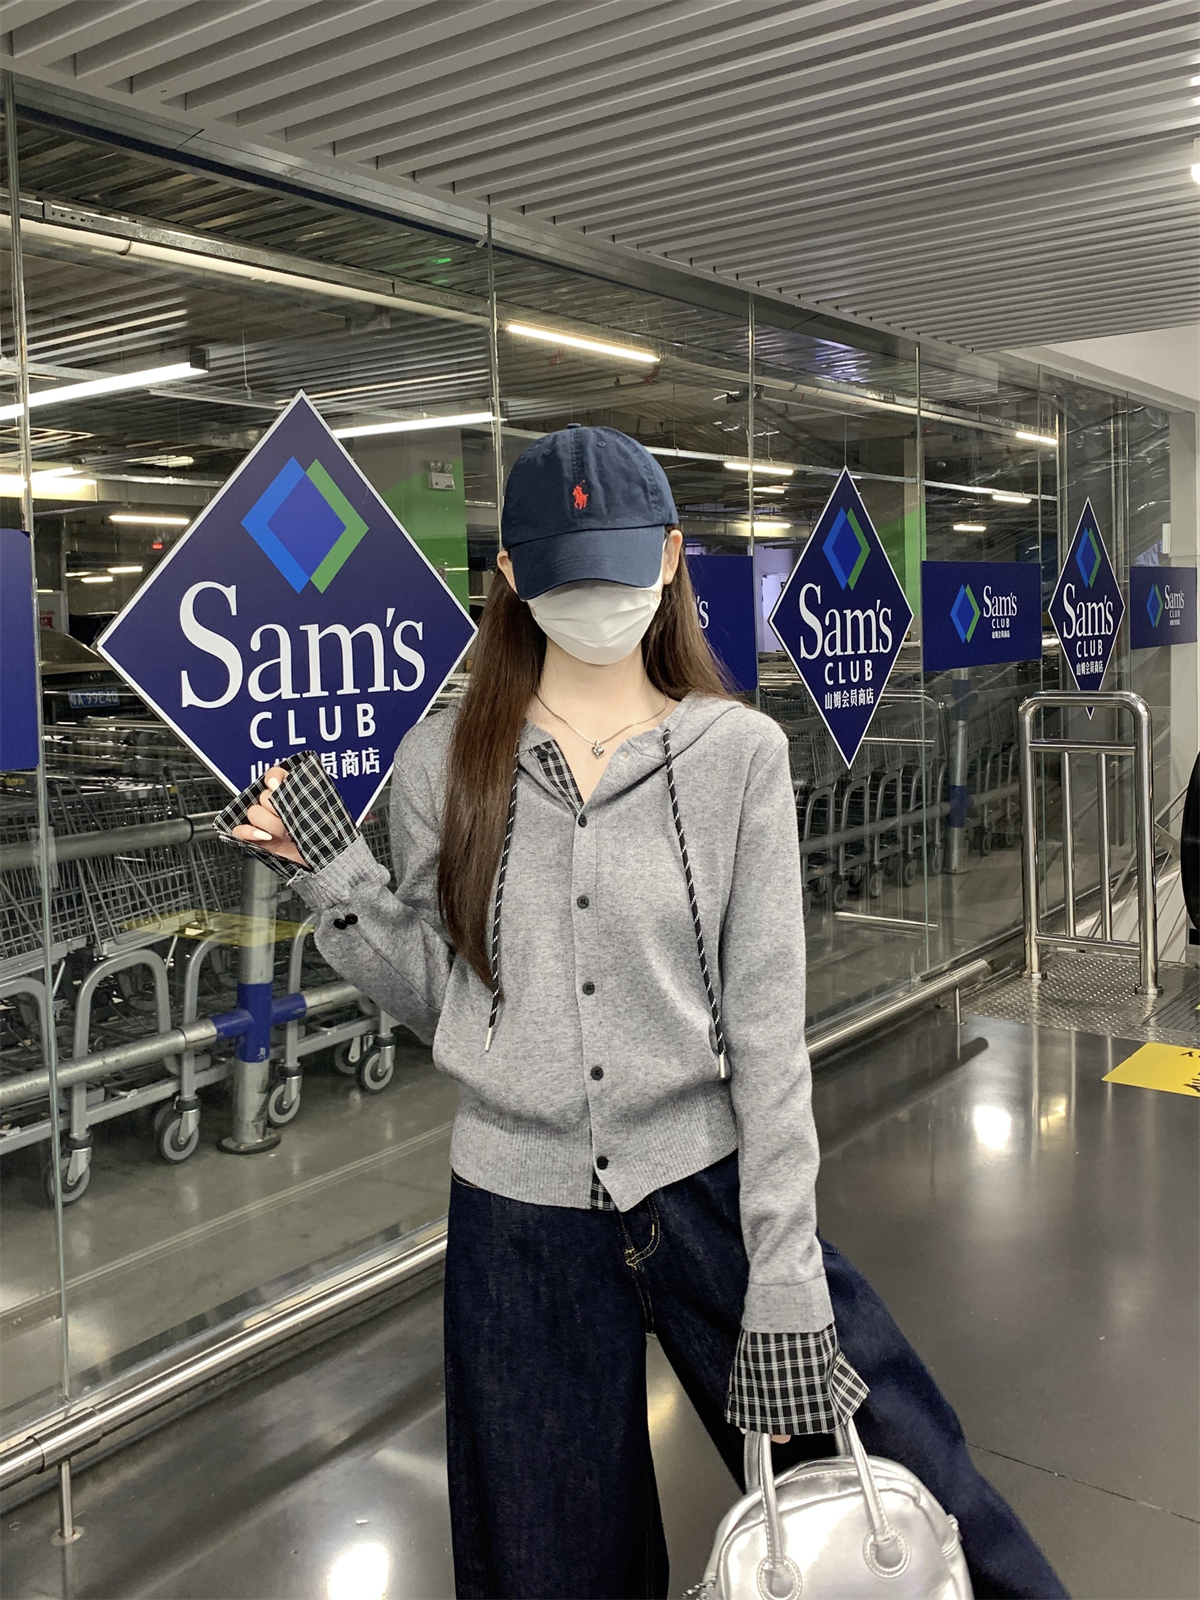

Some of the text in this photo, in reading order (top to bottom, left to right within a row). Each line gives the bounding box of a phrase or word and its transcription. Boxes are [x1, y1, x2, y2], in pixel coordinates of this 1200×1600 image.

[983, 585, 1018, 618] Sam's
[1063, 583, 1114, 639] Sam's
[1164, 584, 1185, 610] Sam's
[799, 583, 893, 660] Sam's
[991, 618, 1010, 629] CLUB
[179, 581, 426, 709] Sam's
[1076, 639, 1103, 658] CLUB
[824, 659, 873, 685] CLUB
[824, 687, 874, 710] 山姆会员商店
[249, 702, 376, 749] CLUB
